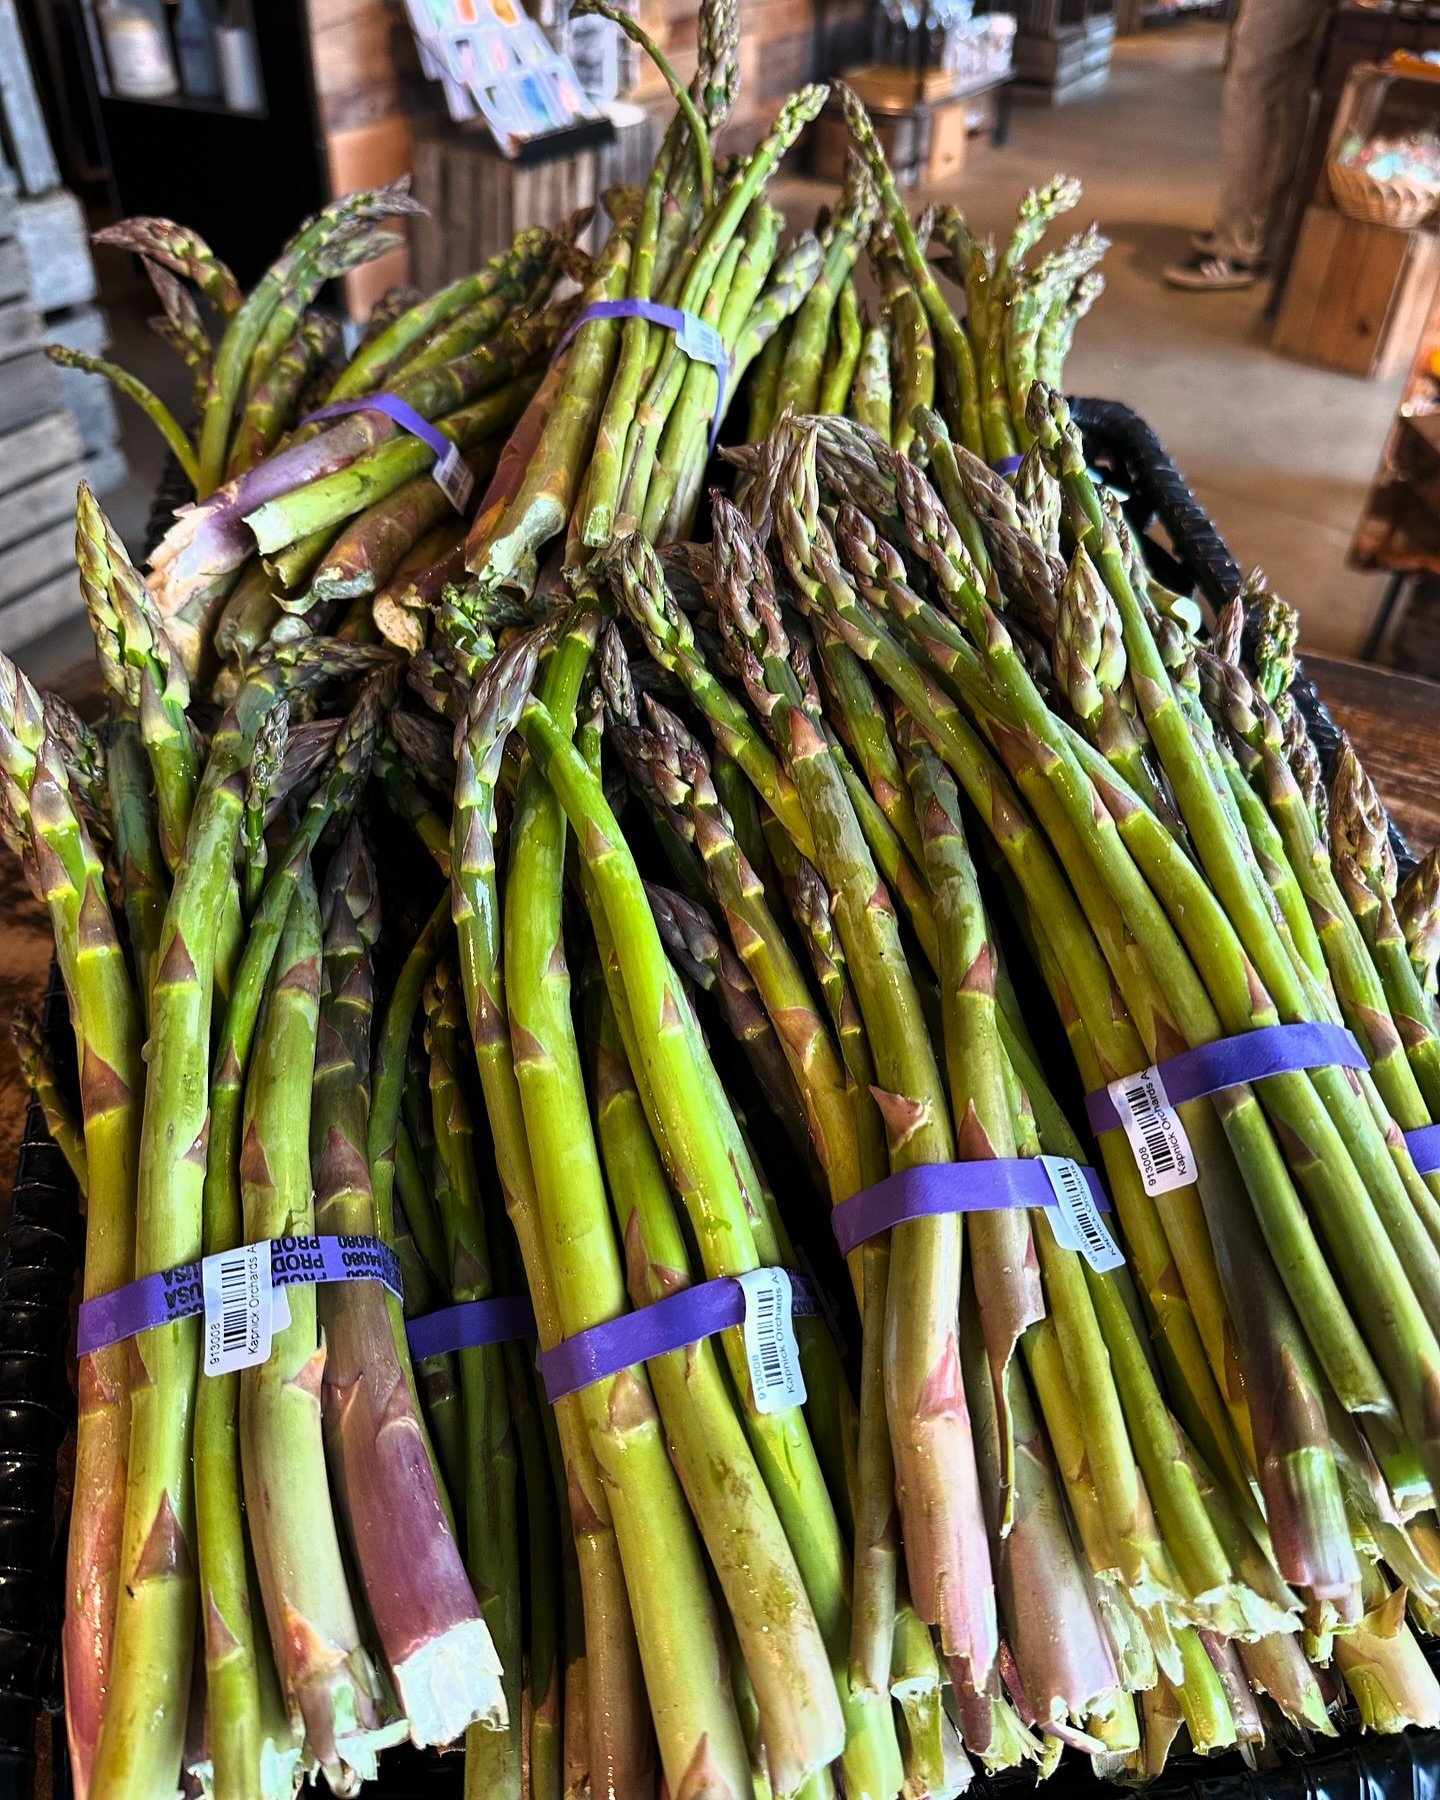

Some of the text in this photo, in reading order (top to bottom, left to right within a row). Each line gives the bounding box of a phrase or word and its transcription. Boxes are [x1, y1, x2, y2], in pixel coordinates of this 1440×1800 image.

[1140, 1069, 1187, 1176] Kapnick Orchards A
[1138, 1146, 1157, 1186] 913008
[1092, 1216, 1117, 1256] Kapnick
[164, 1282, 202, 1309] USA
[247, 1243, 260, 1355] Kapnick Orchards A
[774, 1287, 784, 1342] Orchards
[209, 1322, 221, 1365] 913008
[751, 1354, 767, 1400] 913008
[780, 1344, 795, 1394] Kapnick
